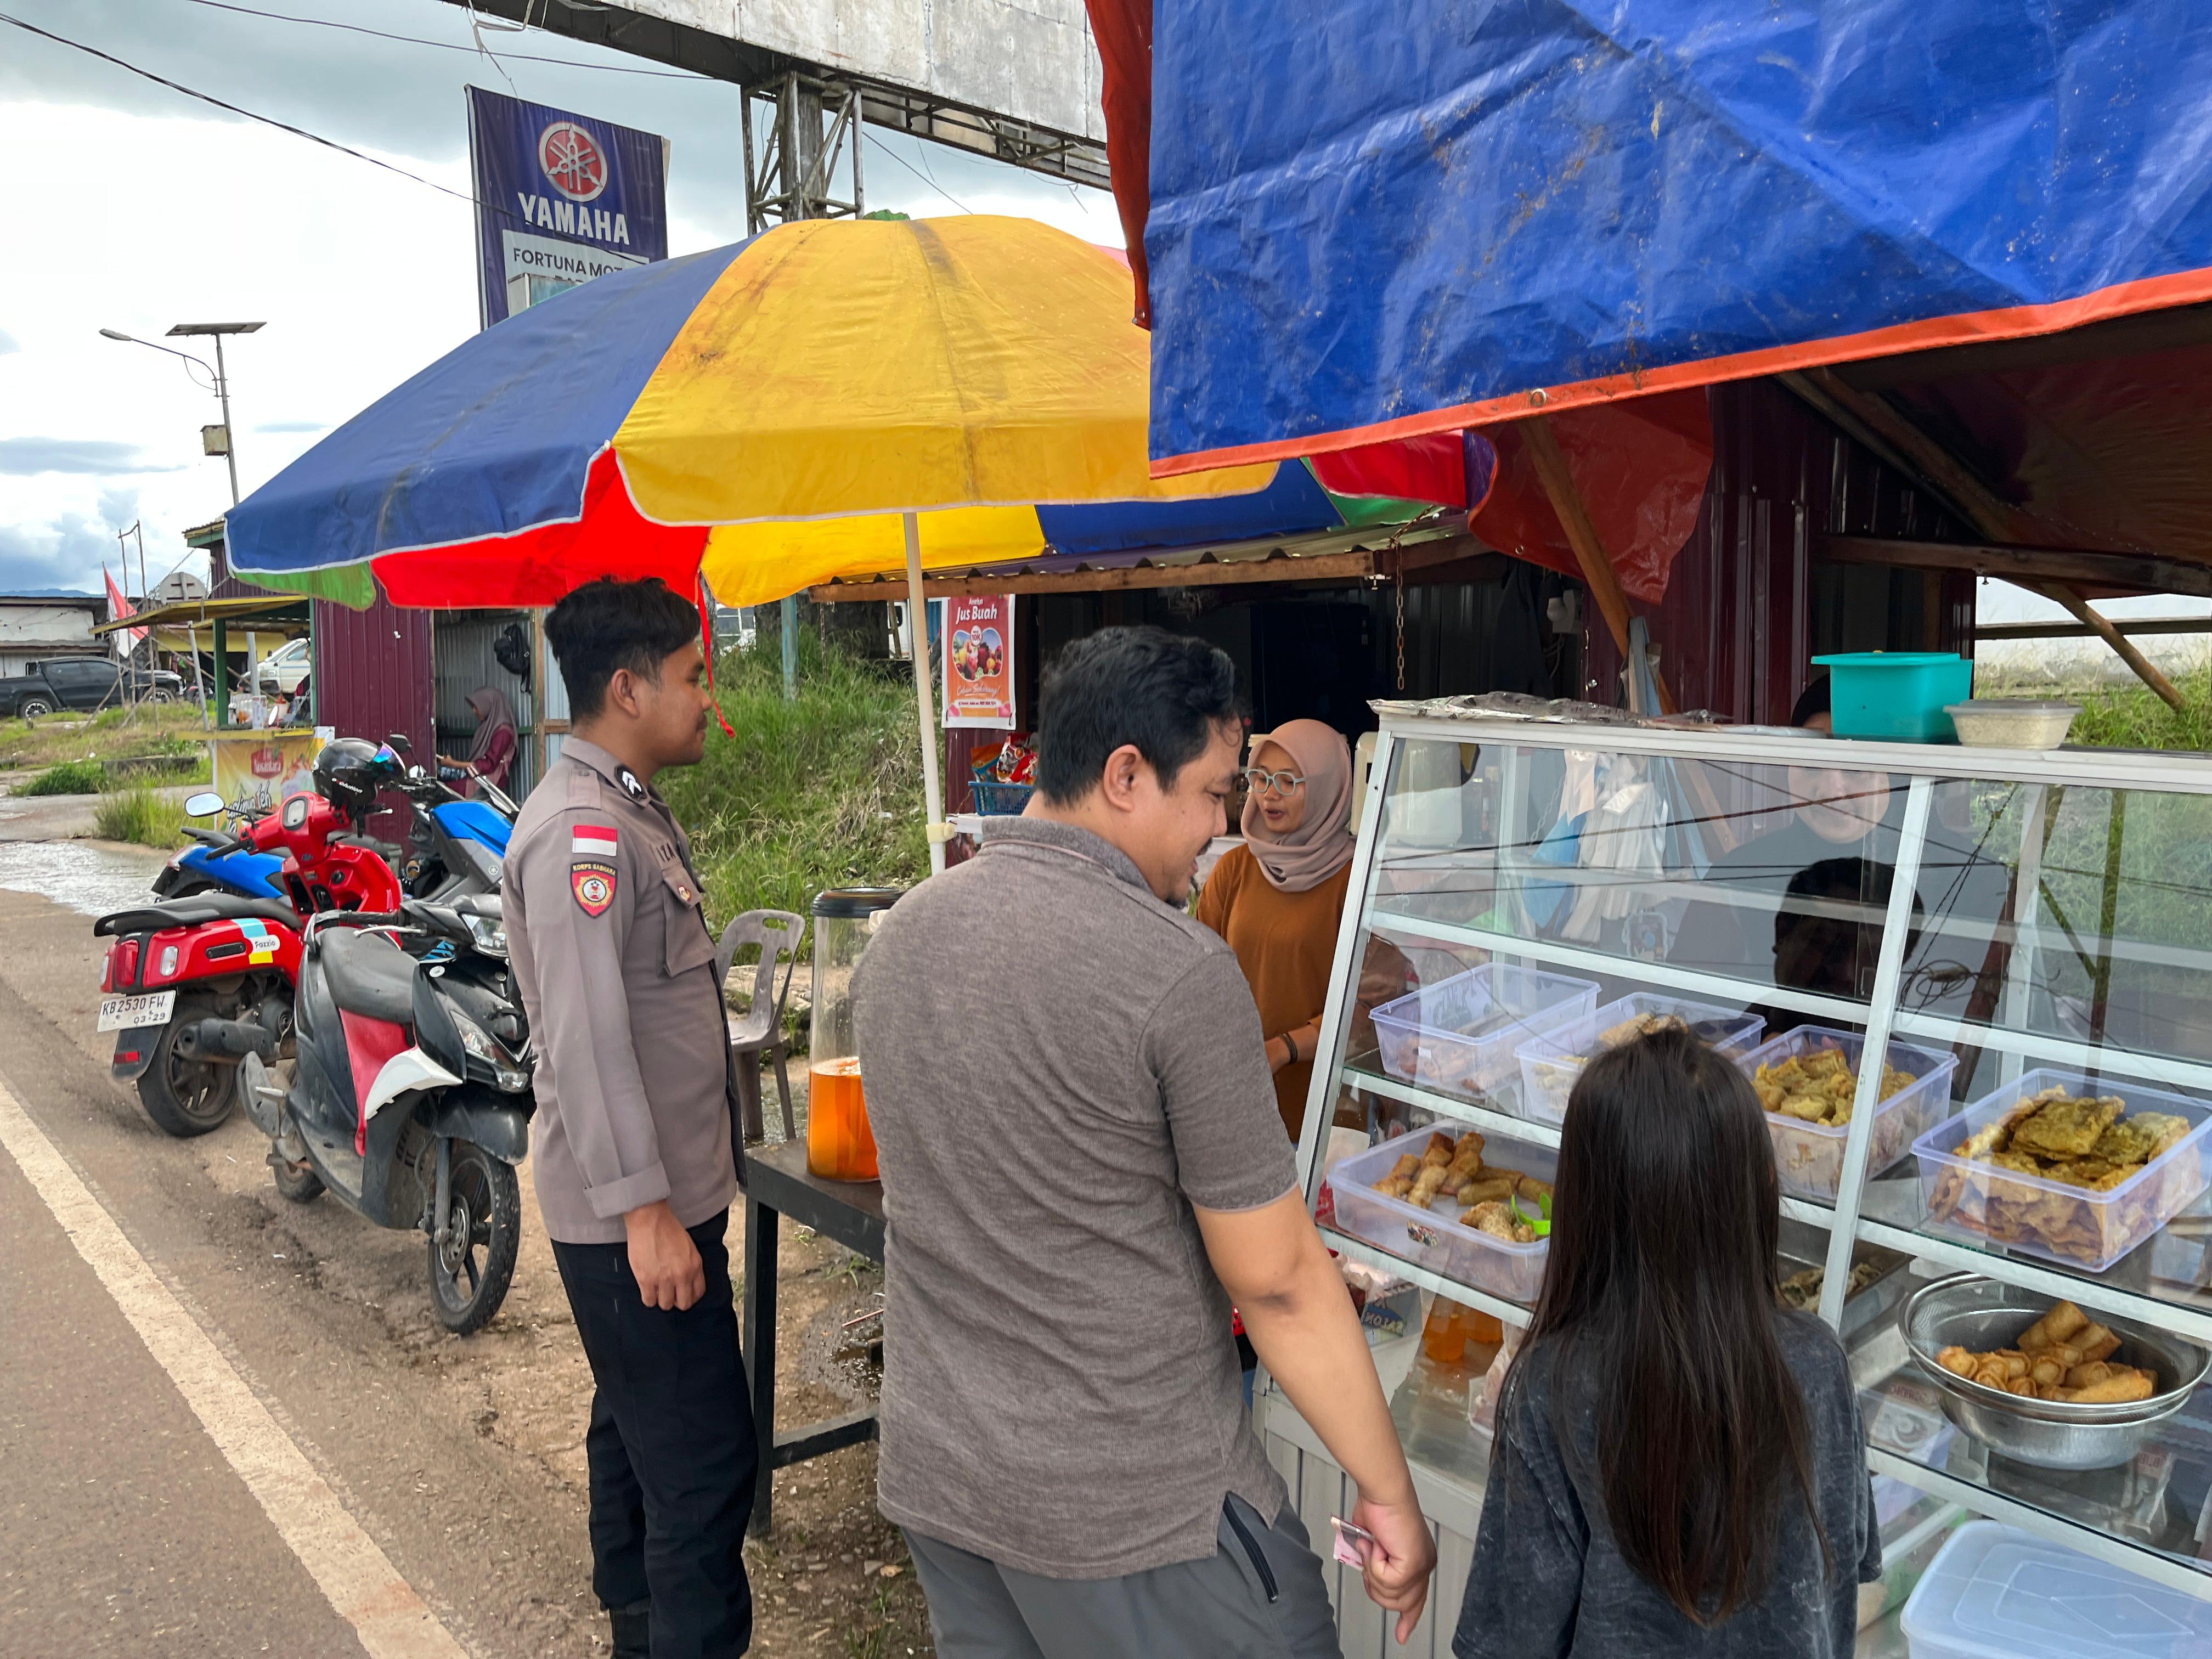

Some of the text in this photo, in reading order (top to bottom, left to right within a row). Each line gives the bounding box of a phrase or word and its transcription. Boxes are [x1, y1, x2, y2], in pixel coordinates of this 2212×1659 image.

[518, 192, 630, 245] YAMAHA
[514, 247, 586, 274] FORTUNA
[956, 603, 997, 624] Jus Buah
[255, 940, 275, 948] Fazzio
[103, 995, 165, 1015] KB 2530 FW
